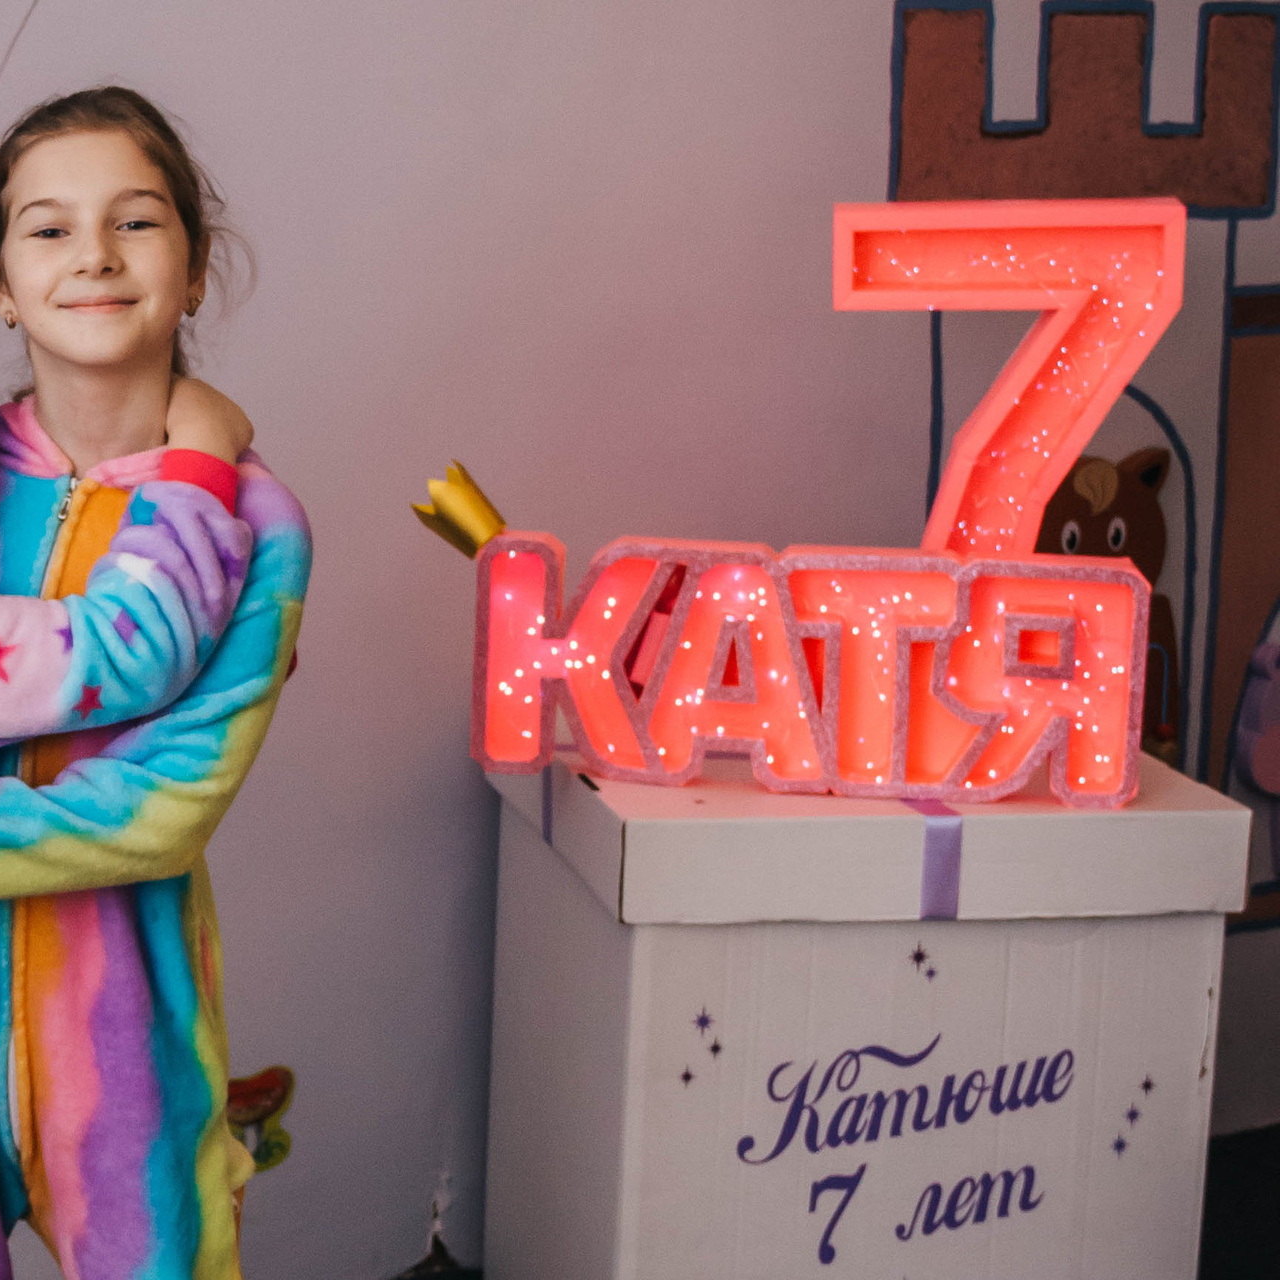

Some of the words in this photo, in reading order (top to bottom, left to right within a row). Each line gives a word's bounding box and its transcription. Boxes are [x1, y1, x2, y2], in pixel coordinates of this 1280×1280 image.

[832, 196, 1187, 558] 7
[470, 529, 1153, 810] КАТЯ
[736, 1031, 1076, 1166] Катюше
[808, 1162, 867, 1266] 7
[894, 1163, 1046, 1243] лет
